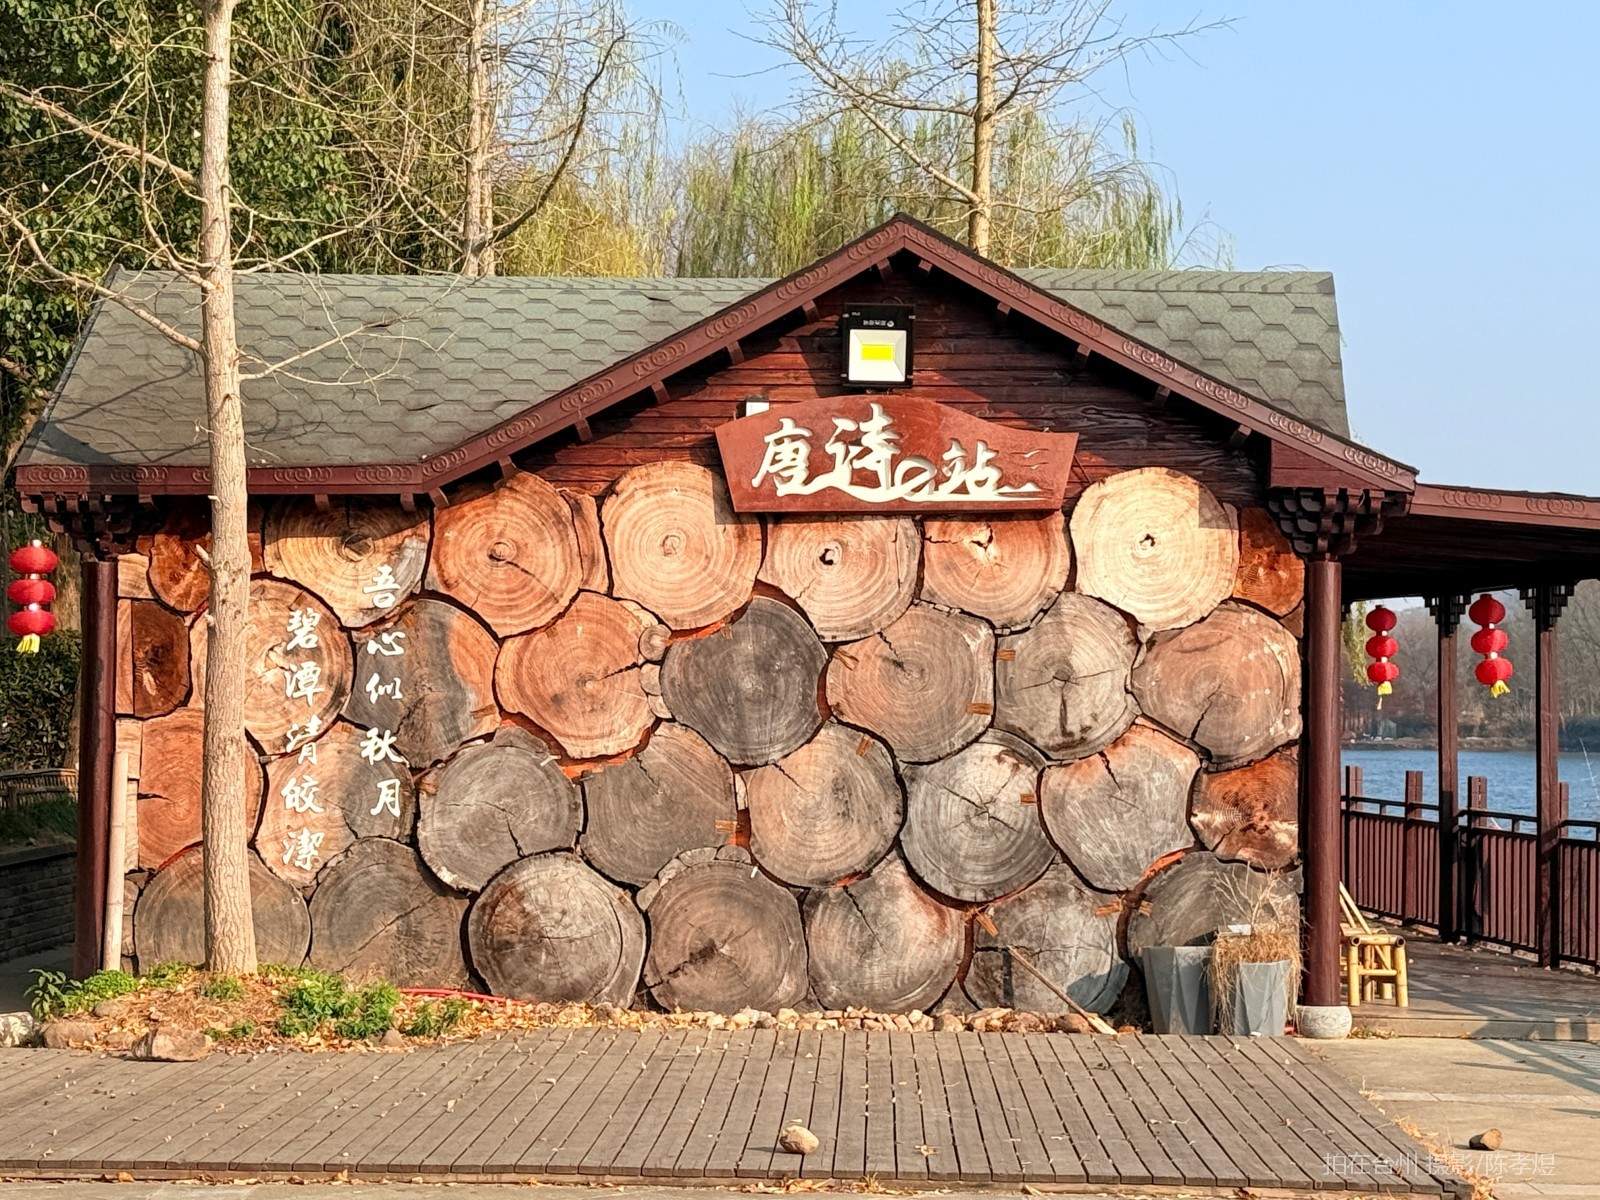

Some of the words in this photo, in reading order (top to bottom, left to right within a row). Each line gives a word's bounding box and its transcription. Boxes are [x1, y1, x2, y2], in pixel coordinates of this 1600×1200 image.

[359, 564, 409, 818] 吾心似秋月
